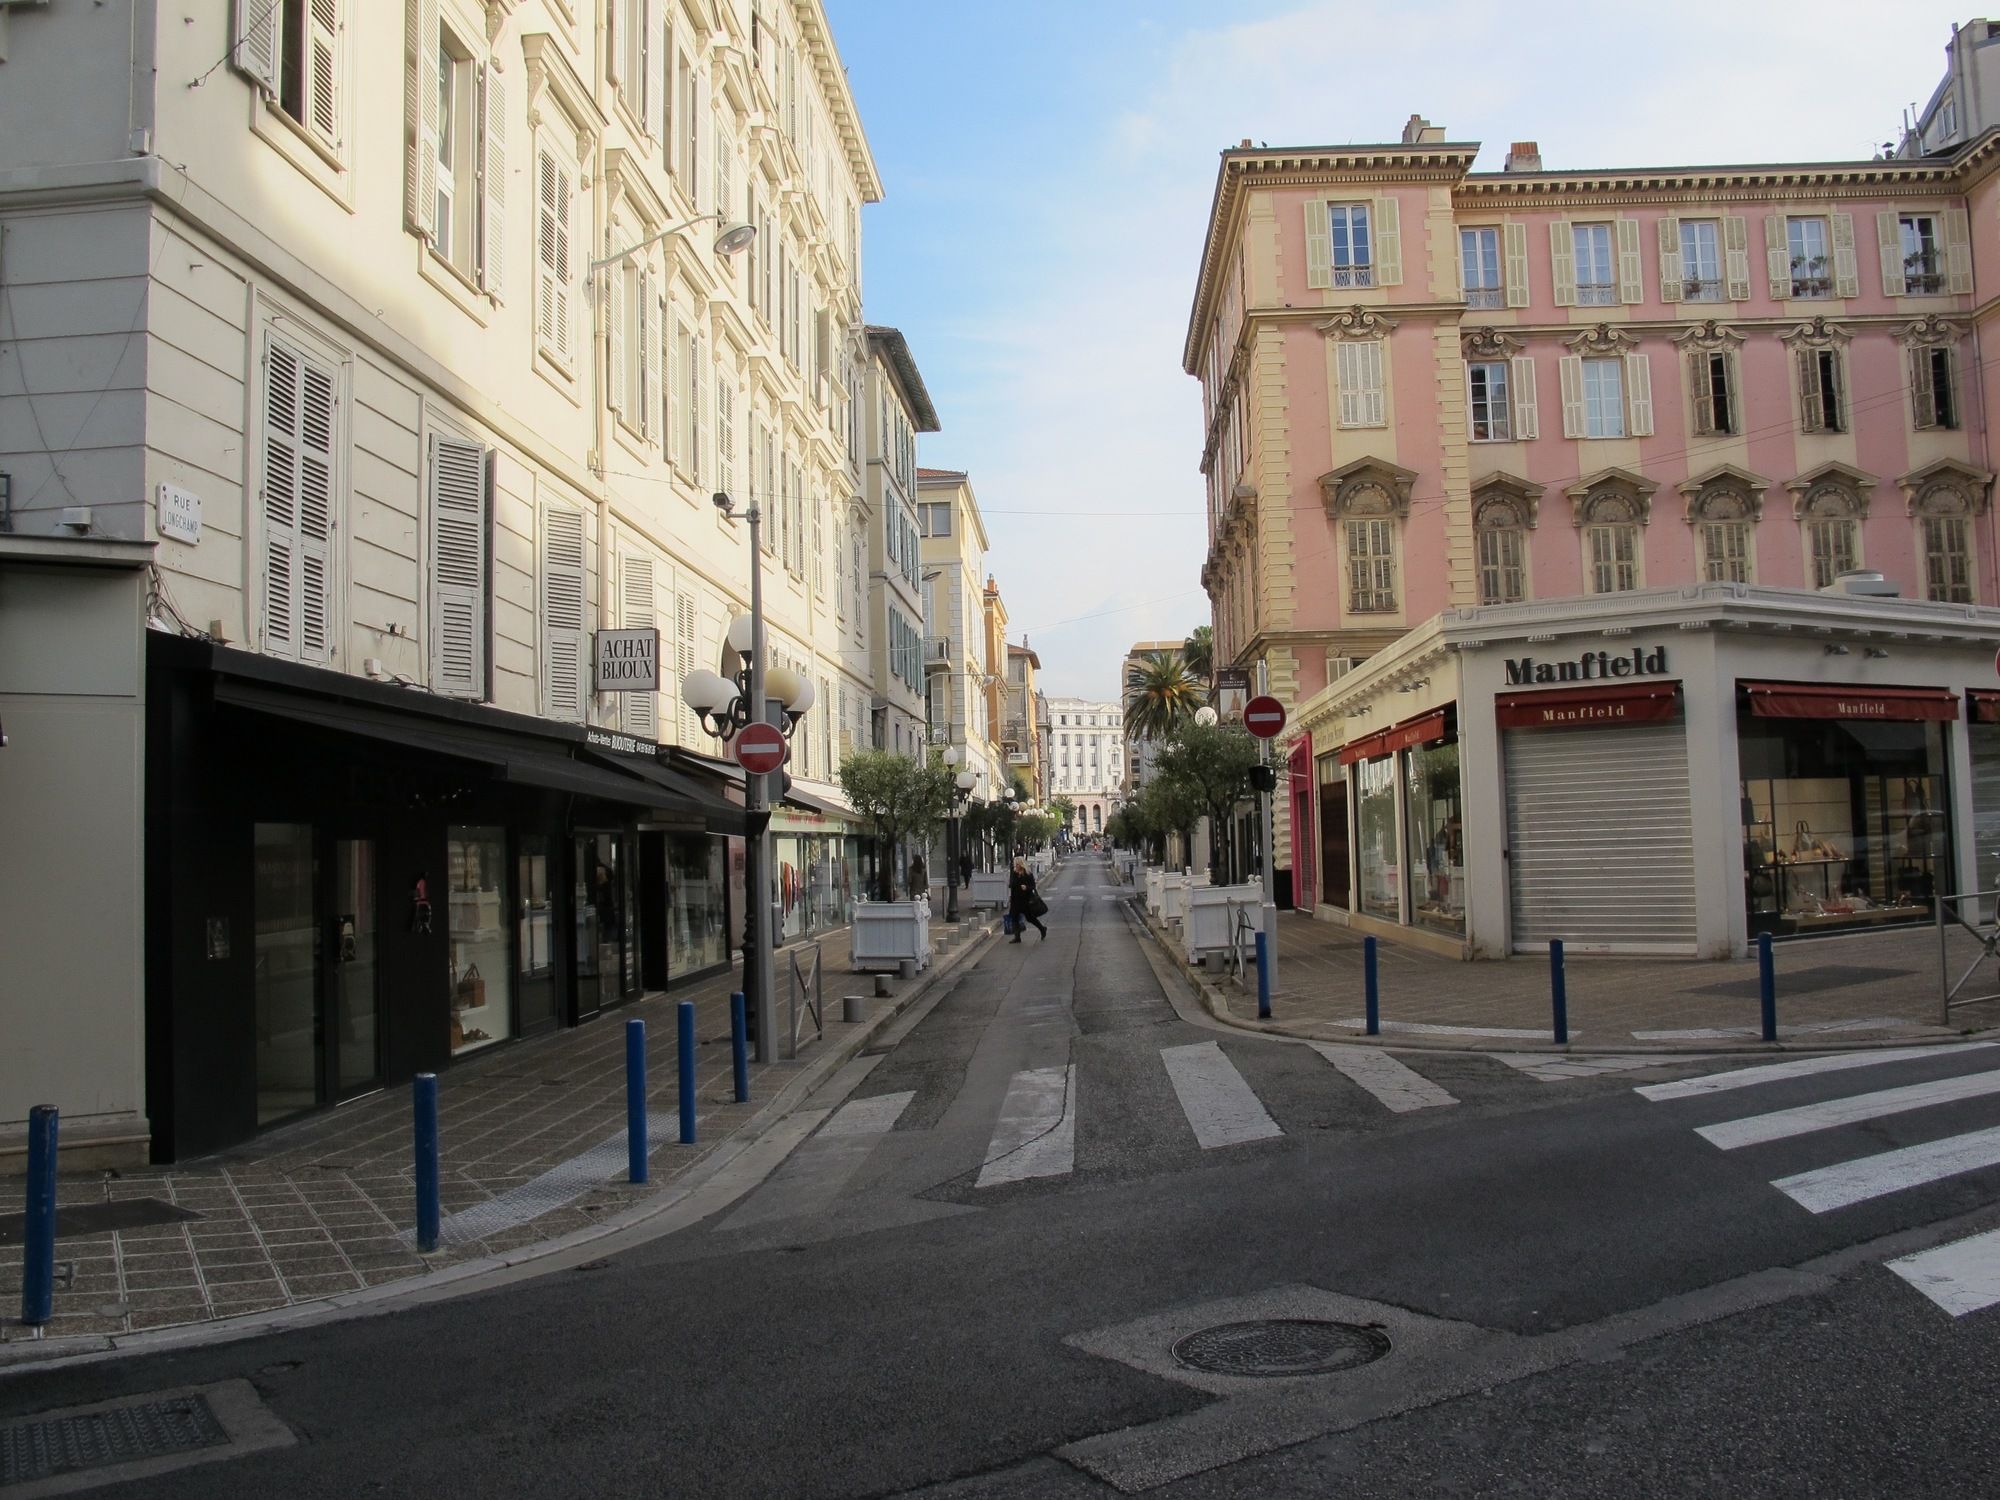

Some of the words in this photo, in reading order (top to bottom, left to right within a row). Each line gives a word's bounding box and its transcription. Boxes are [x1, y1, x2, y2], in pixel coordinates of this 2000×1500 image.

[174, 494, 190, 511] RUE
[165, 511, 198, 533] LONGCHAMP
[602, 639, 653, 658] ACHAT
[602, 660, 652, 679] BIJOUX
[1503, 646, 1669, 685] Manfield
[1543, 705, 1625, 721] Manfield
[1838, 703, 1885, 714] Manfield
[611, 735, 637, 752] BIJOUTERIE
